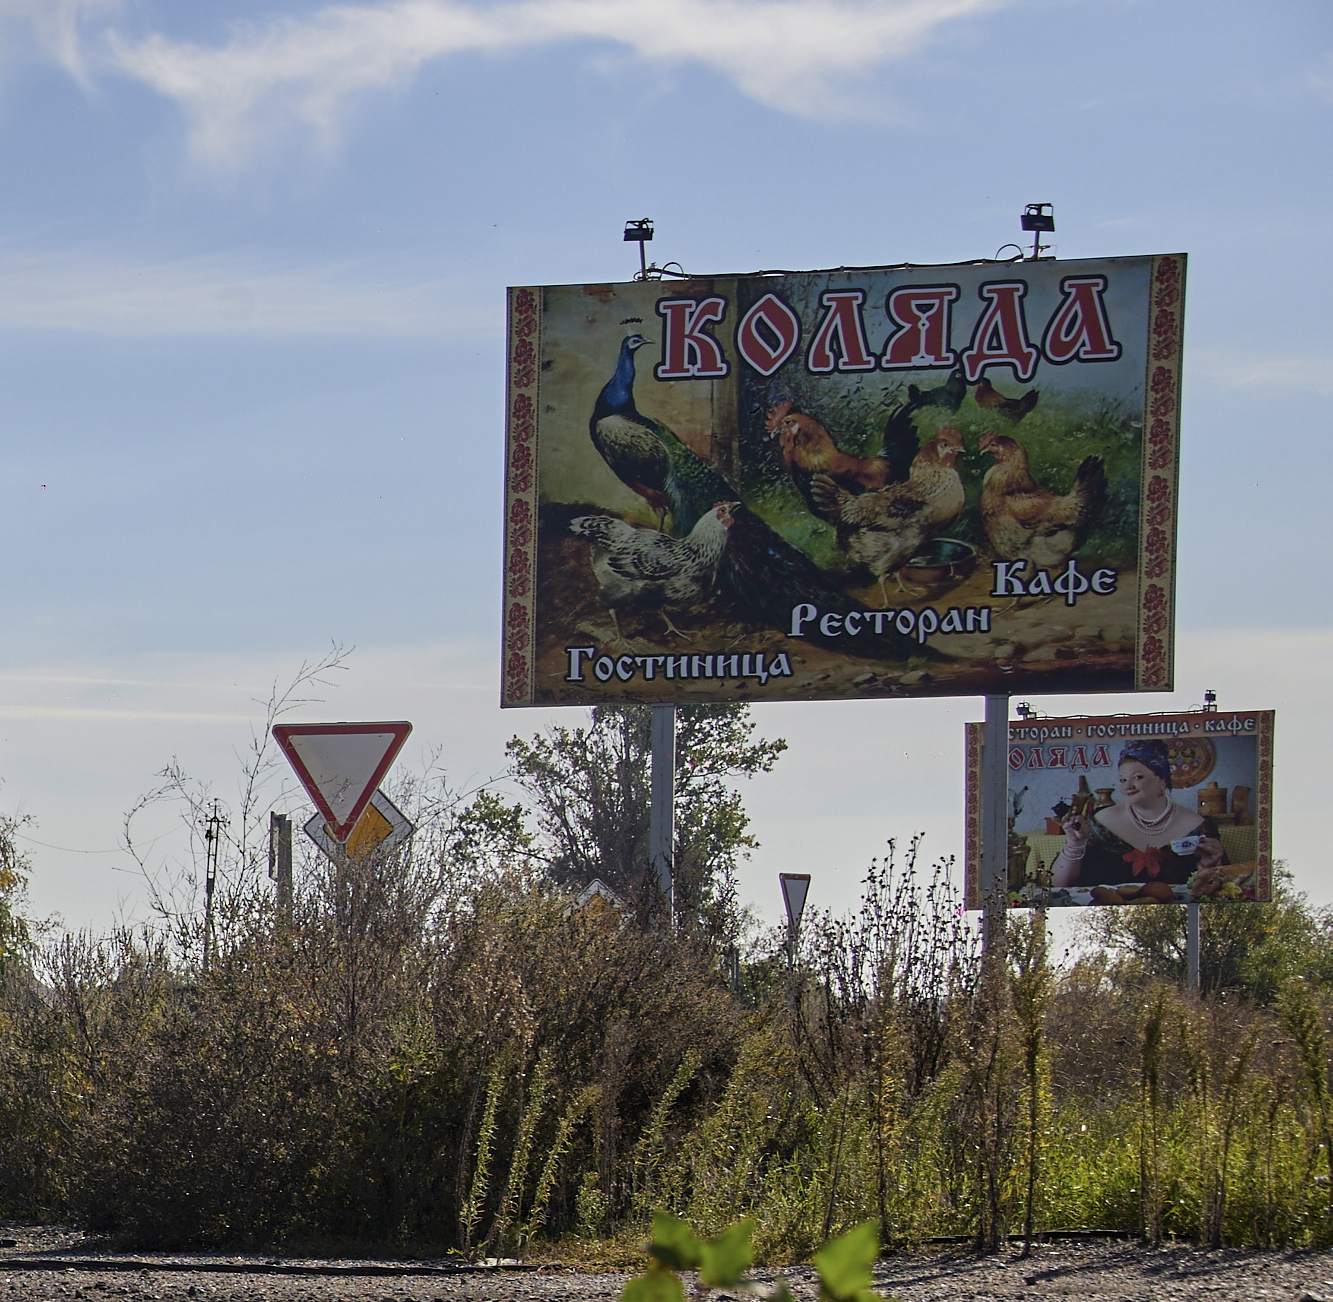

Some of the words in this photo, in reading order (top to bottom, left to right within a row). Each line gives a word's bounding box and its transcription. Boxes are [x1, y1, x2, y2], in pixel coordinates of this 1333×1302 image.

[654, 274, 1122, 383] КОЛЯДА
[786, 601, 990, 643] Ресторан
[566, 647, 793, 686] Гостиница
[1008, 744, 1112, 770] ОЛЯДА
